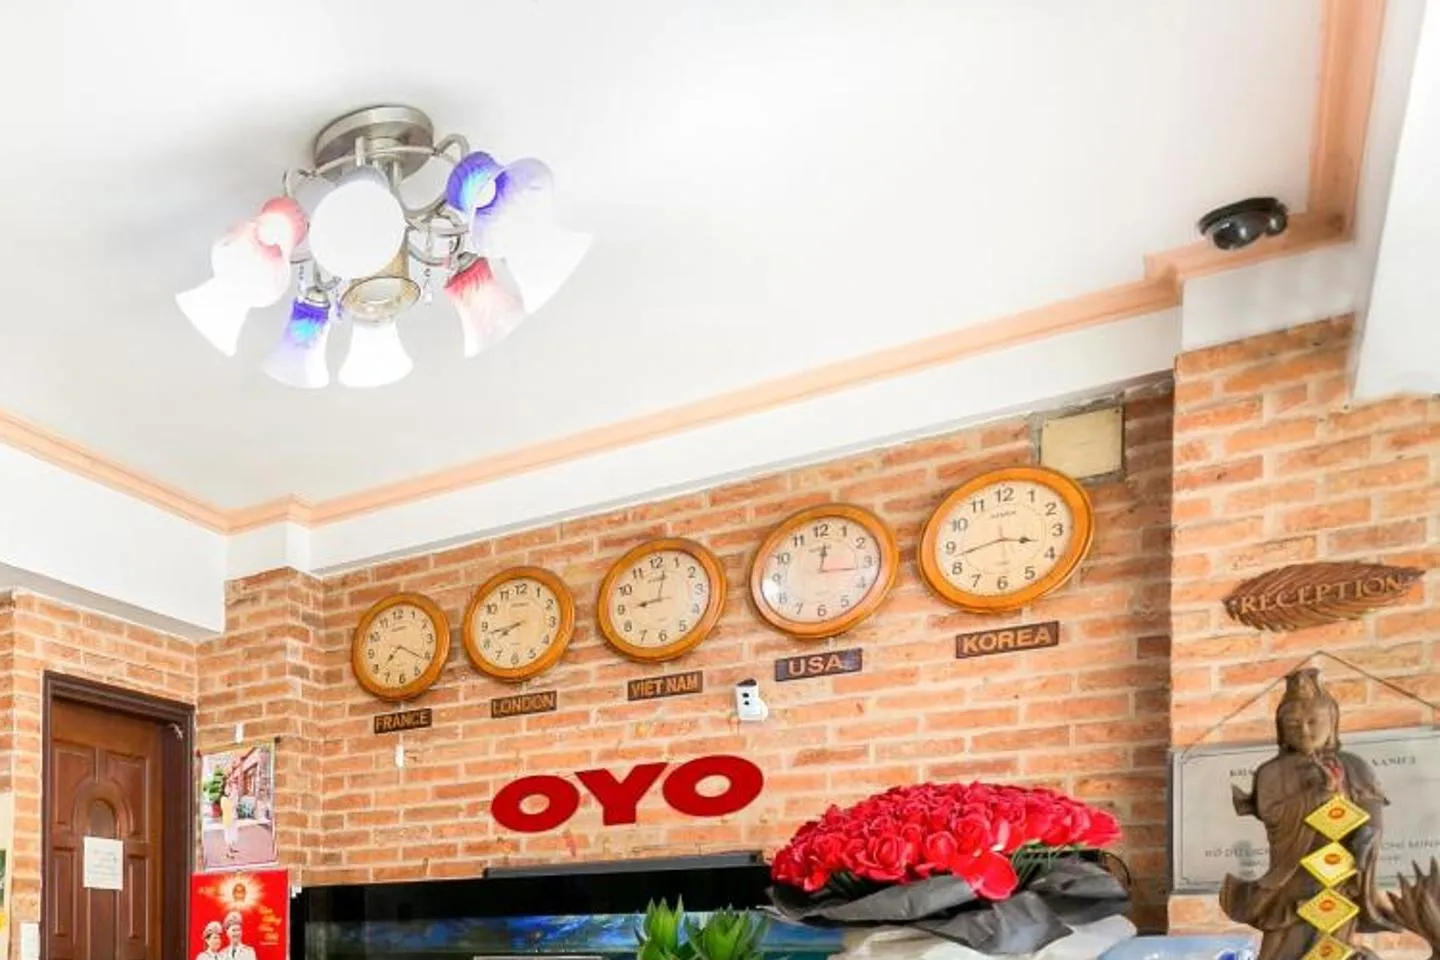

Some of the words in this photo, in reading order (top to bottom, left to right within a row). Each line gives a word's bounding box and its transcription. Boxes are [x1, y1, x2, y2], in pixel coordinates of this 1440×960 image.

[995, 488, 1014, 502] 12
[1027, 490, 1035, 502] 1
[971, 500, 984, 512] 11
[1045, 502, 1056, 516] 2
[952, 518, 968, 531] 10
[1052, 524, 1063, 536] 3
[946, 541, 956, 554] 9
[1044, 547, 1055, 559] 4
[952, 562, 962, 575] 8
[1025, 567, 1035, 580] 5
[971, 575, 980, 588] 7
[997, 576, 1008, 589] 6
[1240, 575, 1402, 614] RECEPTION
[963, 627, 1052, 653] KOREA
[788, 655, 844, 676] USA
[631, 680, 664, 698] VIET
[667, 675, 697, 694] NAM
[493, 694, 555, 715] LONDON
[375, 711, 429, 731] FRANCE
[490, 755, 764, 833] OYO
